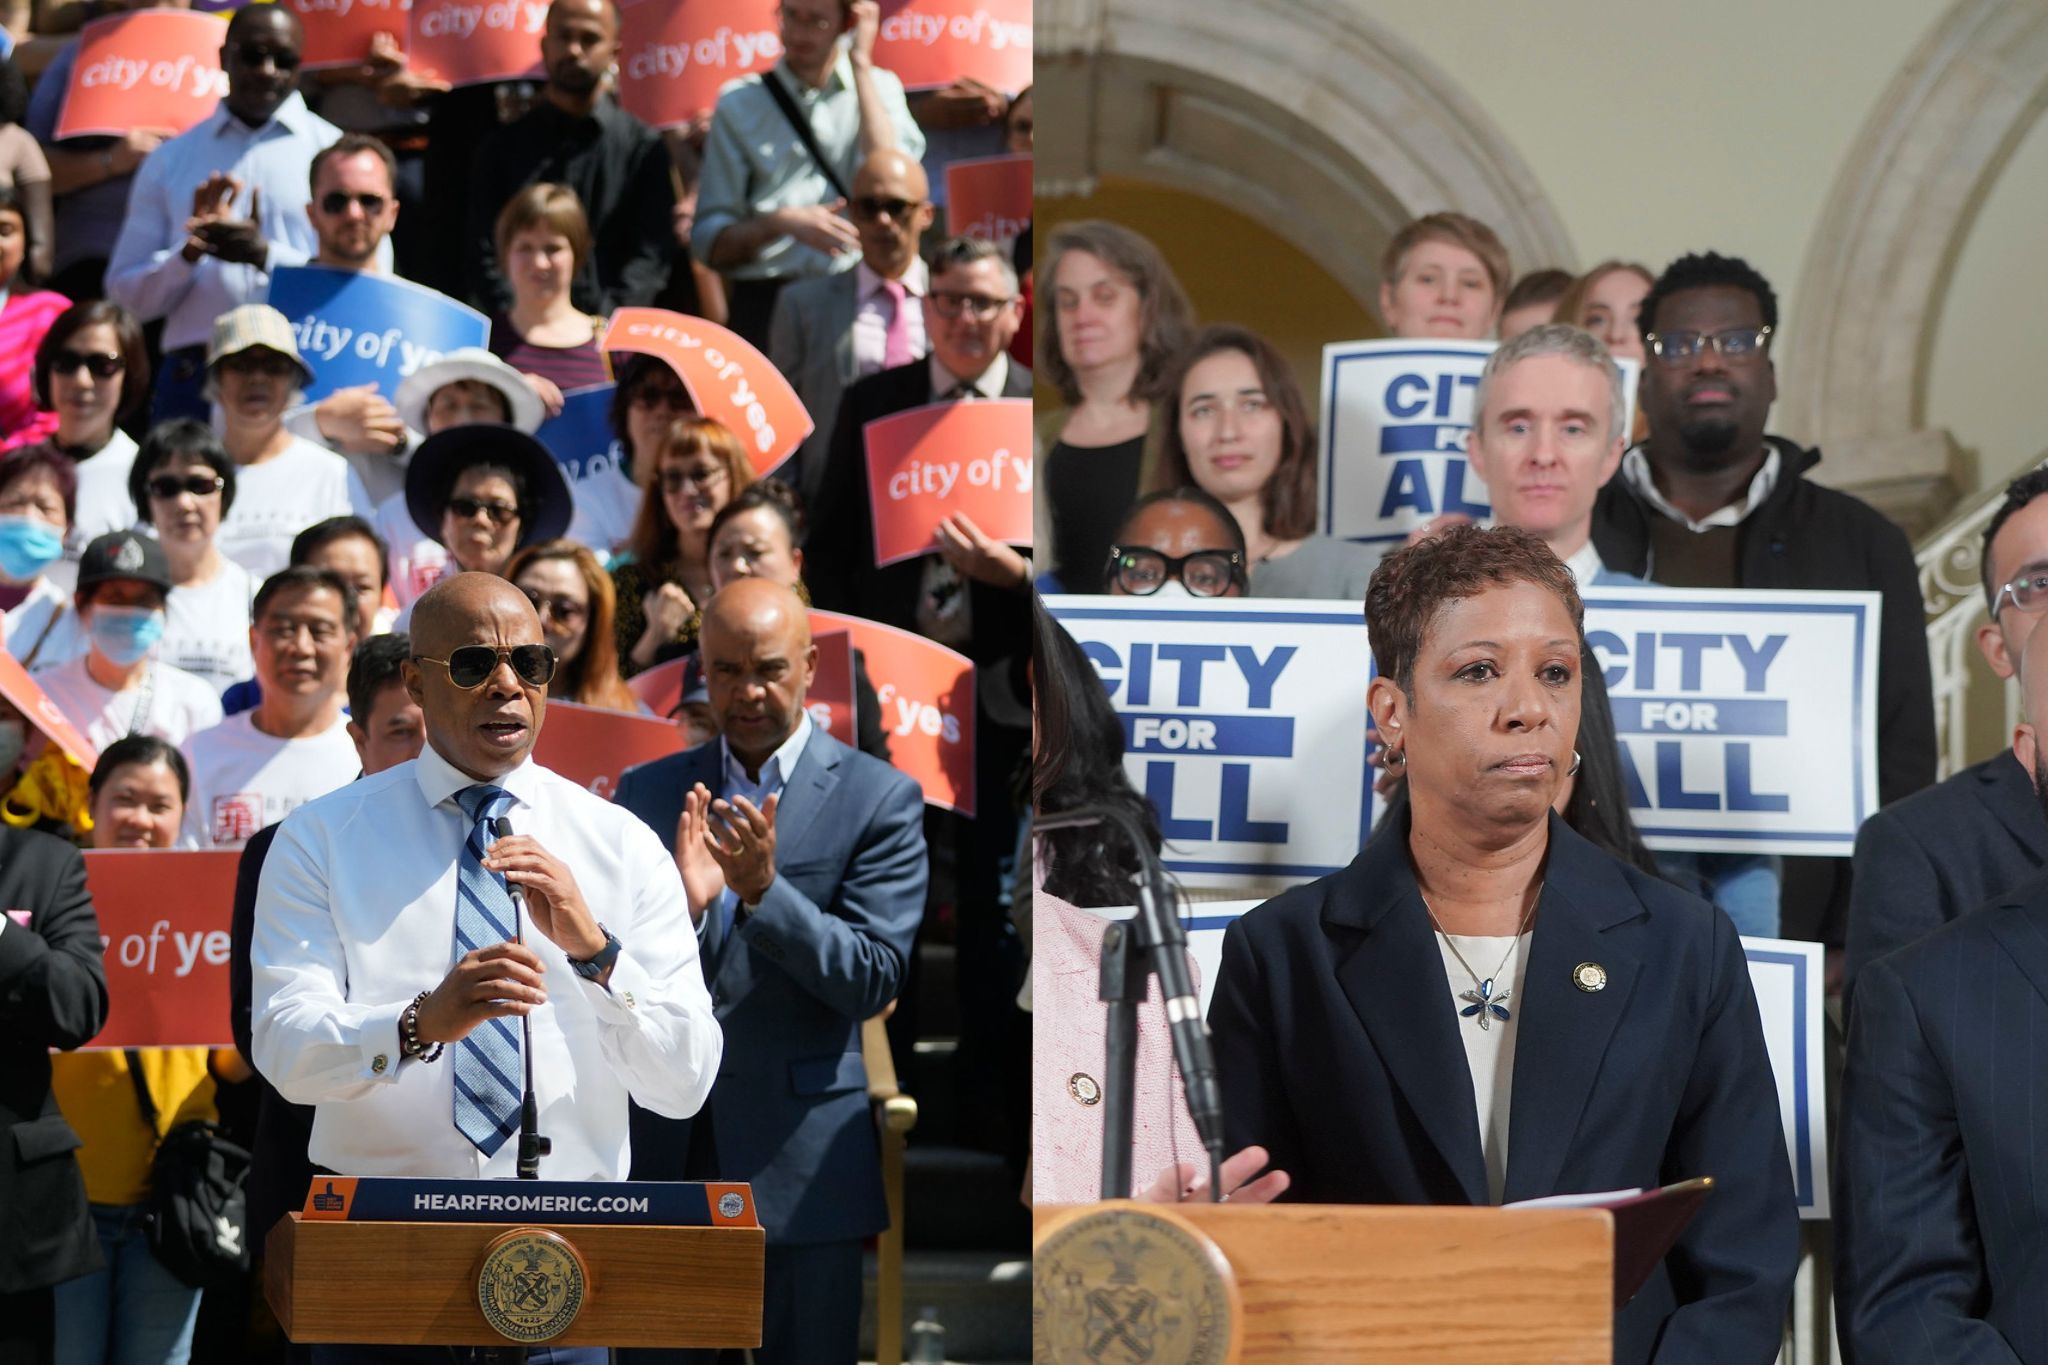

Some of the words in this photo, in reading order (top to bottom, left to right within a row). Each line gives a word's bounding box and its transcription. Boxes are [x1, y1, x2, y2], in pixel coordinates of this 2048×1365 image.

[418, 1, 483, 39] city
[484, 0, 520, 31] of
[881, 8, 947, 47] city
[949, 9, 990, 44] of
[627, 41, 690, 80] city
[693, 25, 732, 68] of
[732, 30, 784, 69] ye
[80, 54, 149, 91] city
[150, 55, 196, 93] of
[355, 328, 402, 368] of
[704, 348, 744, 381] of
[888, 460, 961, 500] city
[966, 448, 1010, 490] of
[896, 696, 961, 744] yes
[1133, 718, 1217, 750] FOR
[1641, 702, 1718, 731] FOR
[120, 919, 170, 975] of
[173, 929, 232, 978] ye
[413, 1194, 649, 1213] HEARFROMERIC.COM
